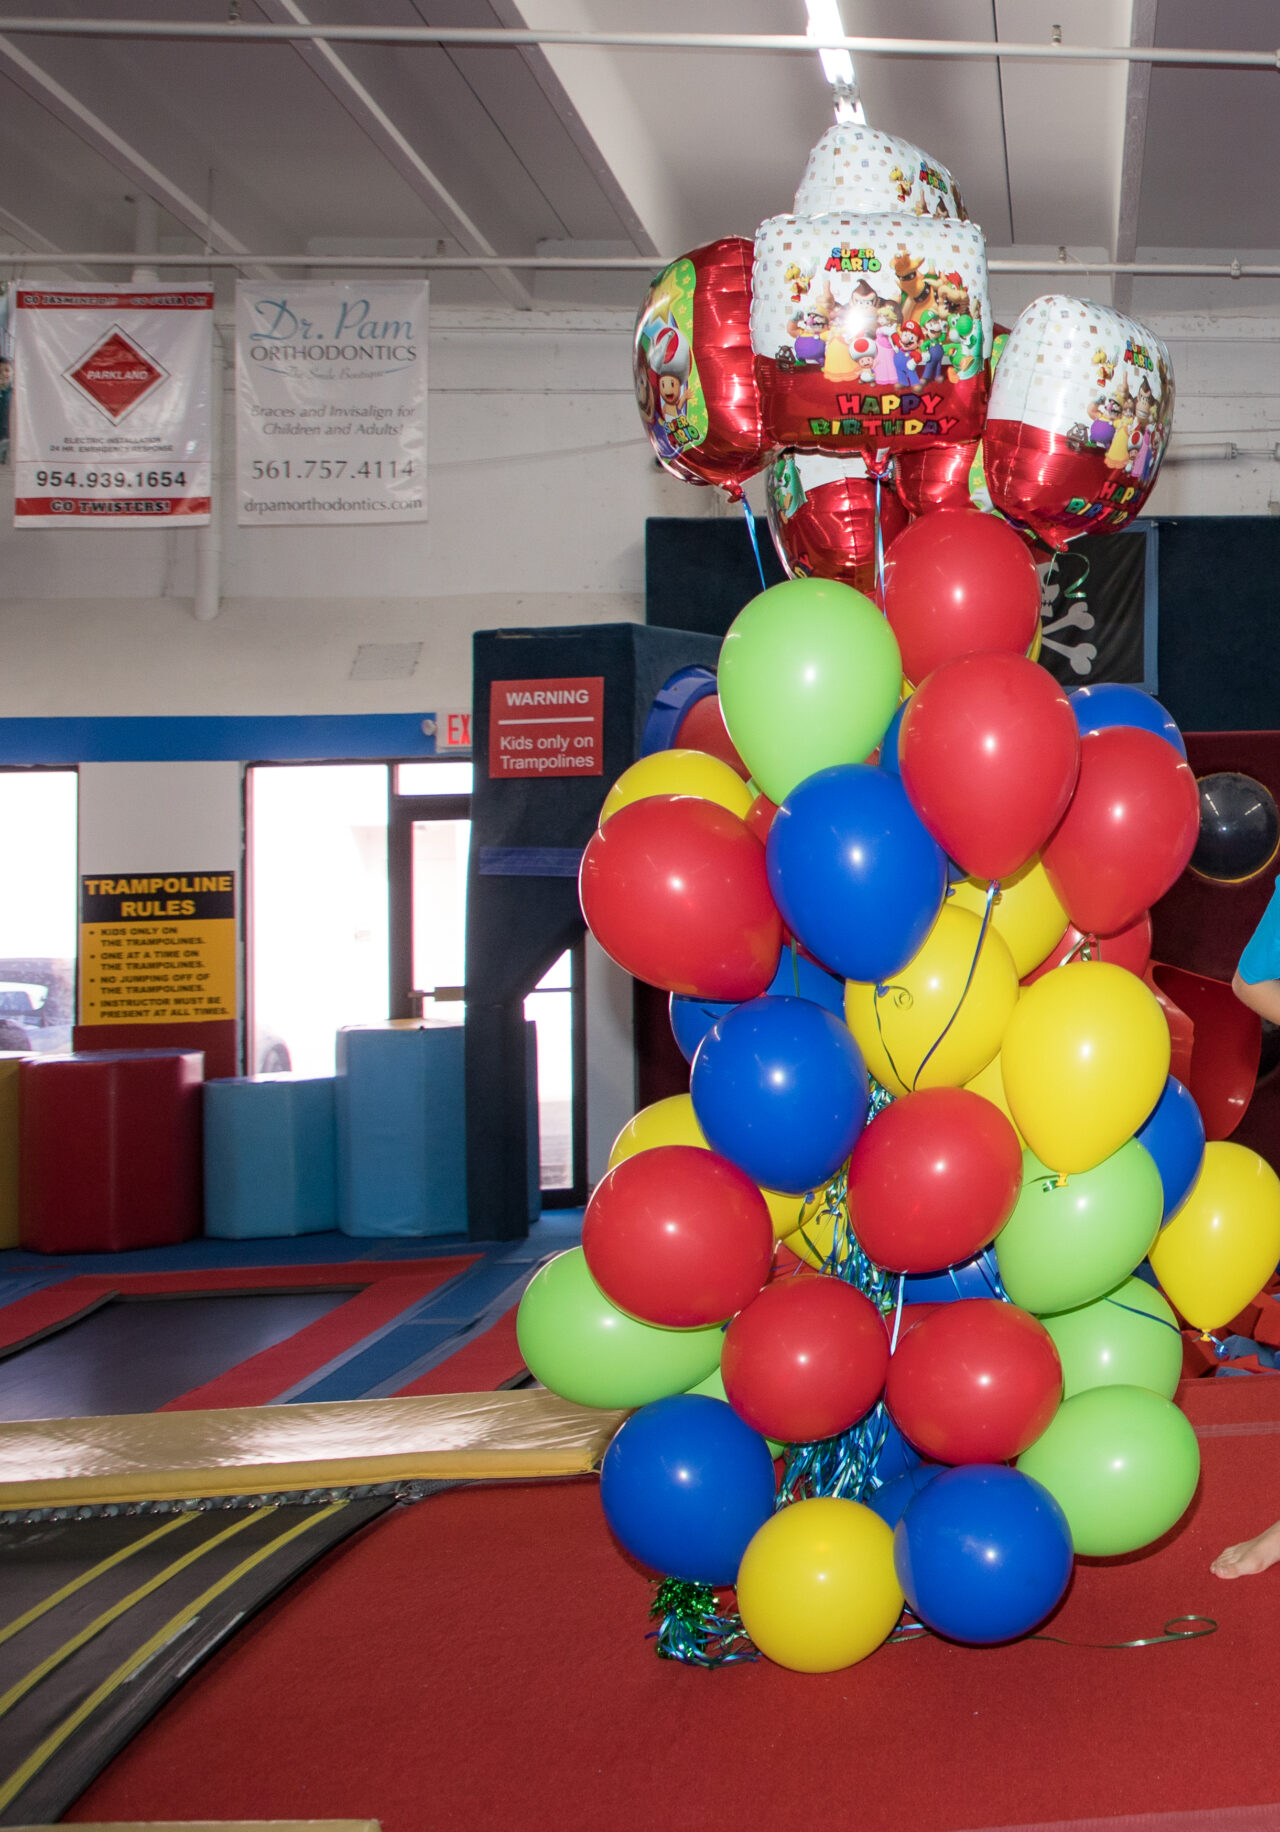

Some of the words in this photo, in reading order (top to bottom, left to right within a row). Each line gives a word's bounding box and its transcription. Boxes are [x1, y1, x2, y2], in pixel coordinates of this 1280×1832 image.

[831, 247, 875, 259] SUPER
[824, 257, 882, 272] MARIO
[249, 299, 324, 341] Dr.
[334, 299, 415, 340] Pam
[250, 345, 417, 362] ORTHODONTICS
[1124, 349, 1154, 372] MARIO
[87, 370, 149, 381] PARKLAND
[251, 405, 296, 418] Braces
[299, 405, 327, 418] and
[329, 404, 393, 421] Invisalign
[397, 404, 417, 418] for
[837, 393, 944, 416] HAPPY
[263, 422, 321, 436] Children
[324, 422, 352, 436] and
[663, 415, 689, 434] SUPER
[808, 418, 959, 436] BIRTHDAY
[667, 425, 700, 448] MARIO
[251, 459, 415, 480] 561.757.4114
[36, 470, 187, 489] 954.939.1654
[1099, 481, 1142, 505] HAPP
[50, 500, 75, 513] GO
[79, 500, 171, 514] TWISTERS!
[244, 498, 423, 515] drpamorthodontics.com
[506, 689, 590, 706] WARNING
[447, 714, 472, 745] EX
[500, 736, 533, 751] Kids
[537, 734, 570, 752] only
[573, 736, 594, 748] on
[500, 754, 595, 772] Trampolines
[84, 876, 233, 896] TRAMPOLINE
[120, 900, 196, 917] RULES
[100, 928, 126, 936] KIDS
[130, 927, 160, 936] ONLY
[162, 926, 178, 935] ON
[100, 939, 122, 947] THE
[126, 937, 205, 947] TRAMPOLINES.
[100, 951, 123, 960] ONE
[126, 951, 141, 960] AT
[143, 951, 152, 959] A
[154, 950, 180, 959] TIME
[183, 949, 199, 958] ON
[100, 963, 122, 971] THE
[126, 961, 205, 971] TRAMPOLINES.
[100, 975, 117, 984] NO
[120, 974, 169, 984] JUMPING
[172, 973, 193, 983] OFF
[196, 973, 211, 982] OF
[100, 986, 122, 995] THE
[126, 984, 205, 994] TRAMPOLINES.
[100, 997, 171, 1008] INSTRUCTOR
[174, 996, 203, 1006] MUST
[207, 996, 222, 1005] BE
[100, 1009, 151, 1019] PRESENT
[153, 1009, 168, 1018] AT
[170, 1008, 191, 1017] ALL
[194, 1007, 230, 1016] TIMES.
